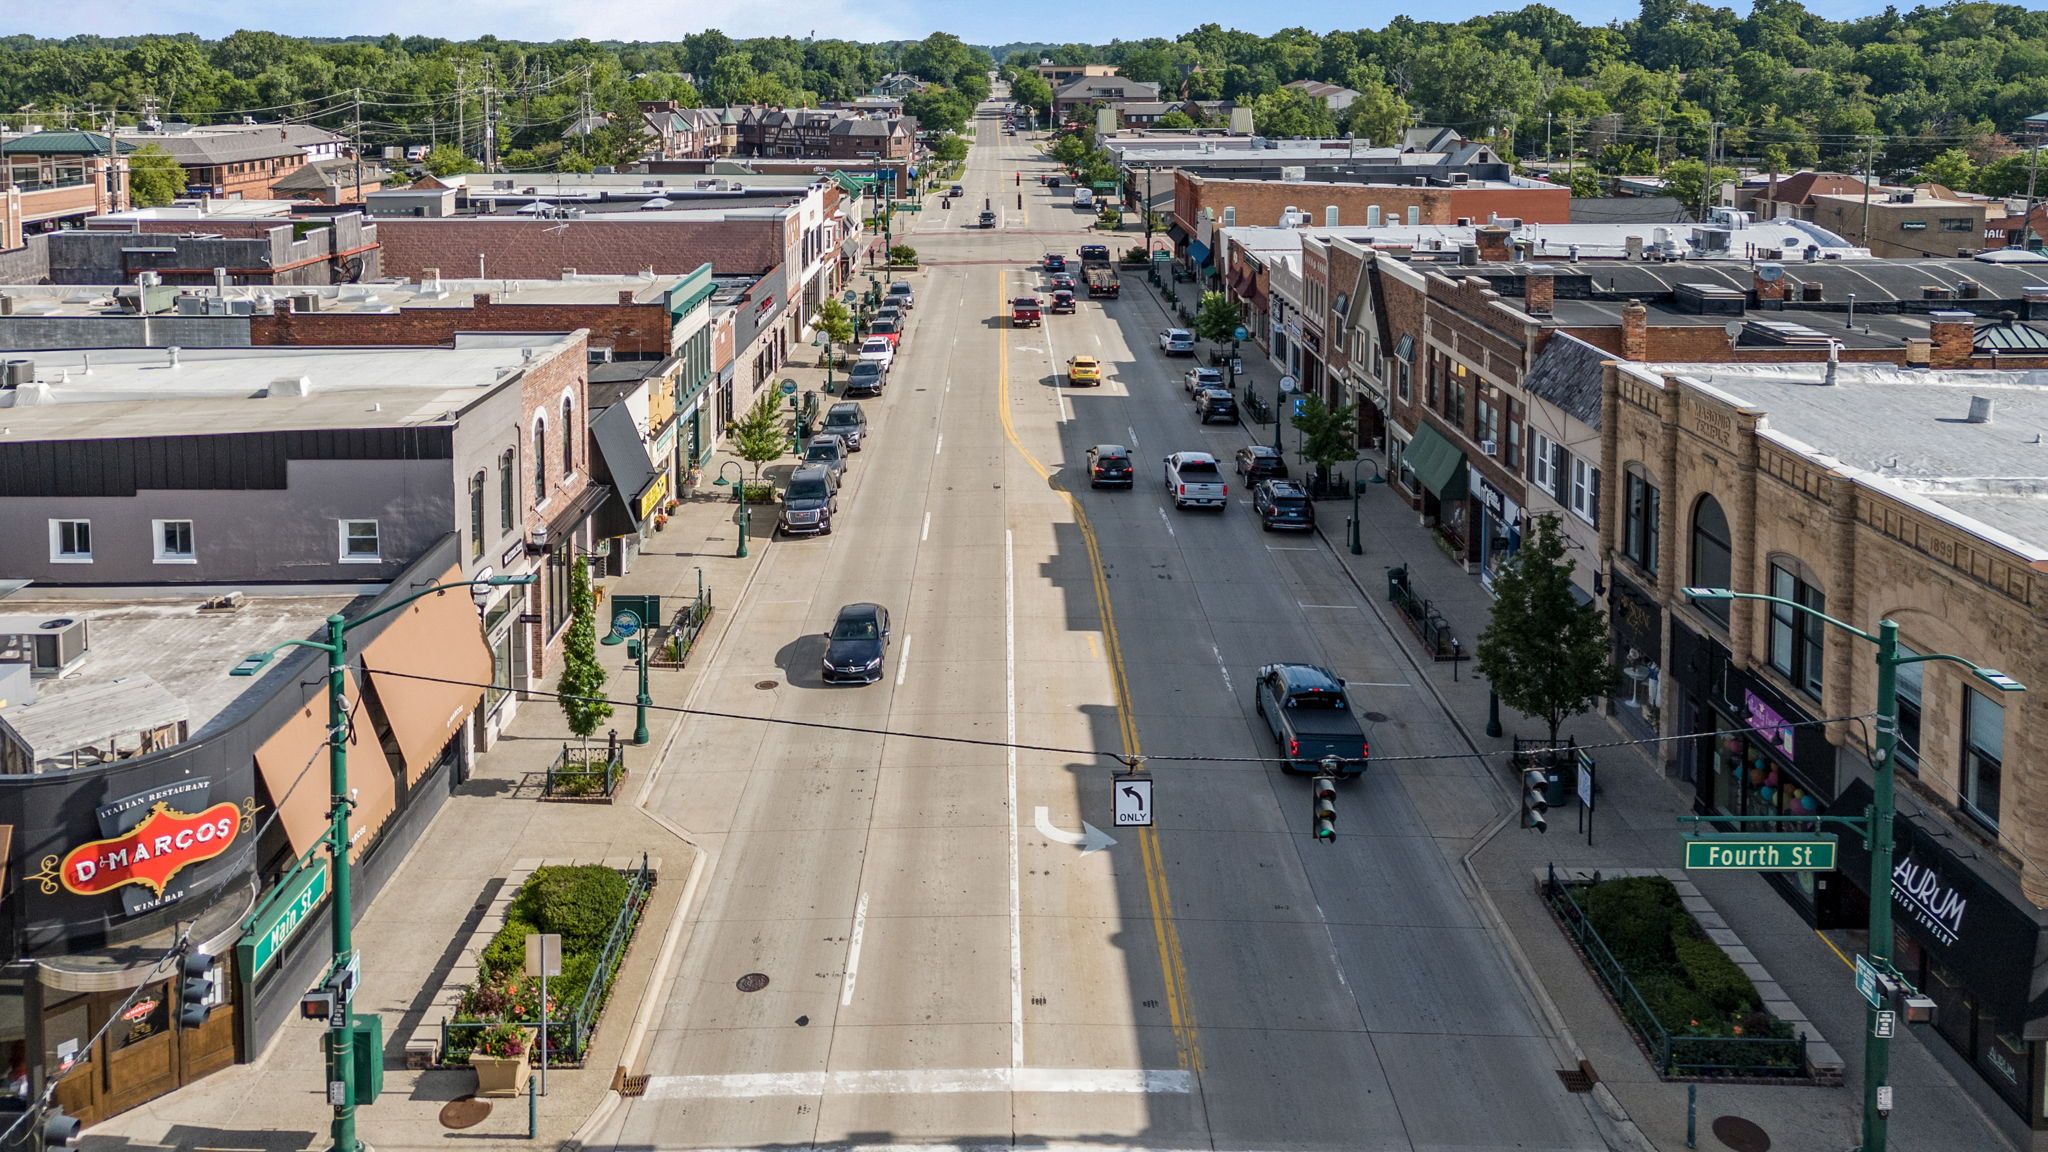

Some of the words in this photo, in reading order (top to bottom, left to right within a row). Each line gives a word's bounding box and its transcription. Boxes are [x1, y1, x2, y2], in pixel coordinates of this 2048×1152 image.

[1930, 536, 1953, 558] 1899
[101, 797, 144, 819] ITALIAN
[149, 781, 210, 801] RESTAURANT
[1120, 813, 1147, 822] ONLY
[1709, 845, 1779, 866] Fourth
[1791, 846, 1813, 866] St
[133, 898, 161, 913] WINE
[165, 890, 184, 902] BAR
[1890, 887, 1915, 912] ESIGN
[1892, 856, 1967, 932] AURUM
[271, 909, 297, 953] Main
[301, 888, 312, 915] St
